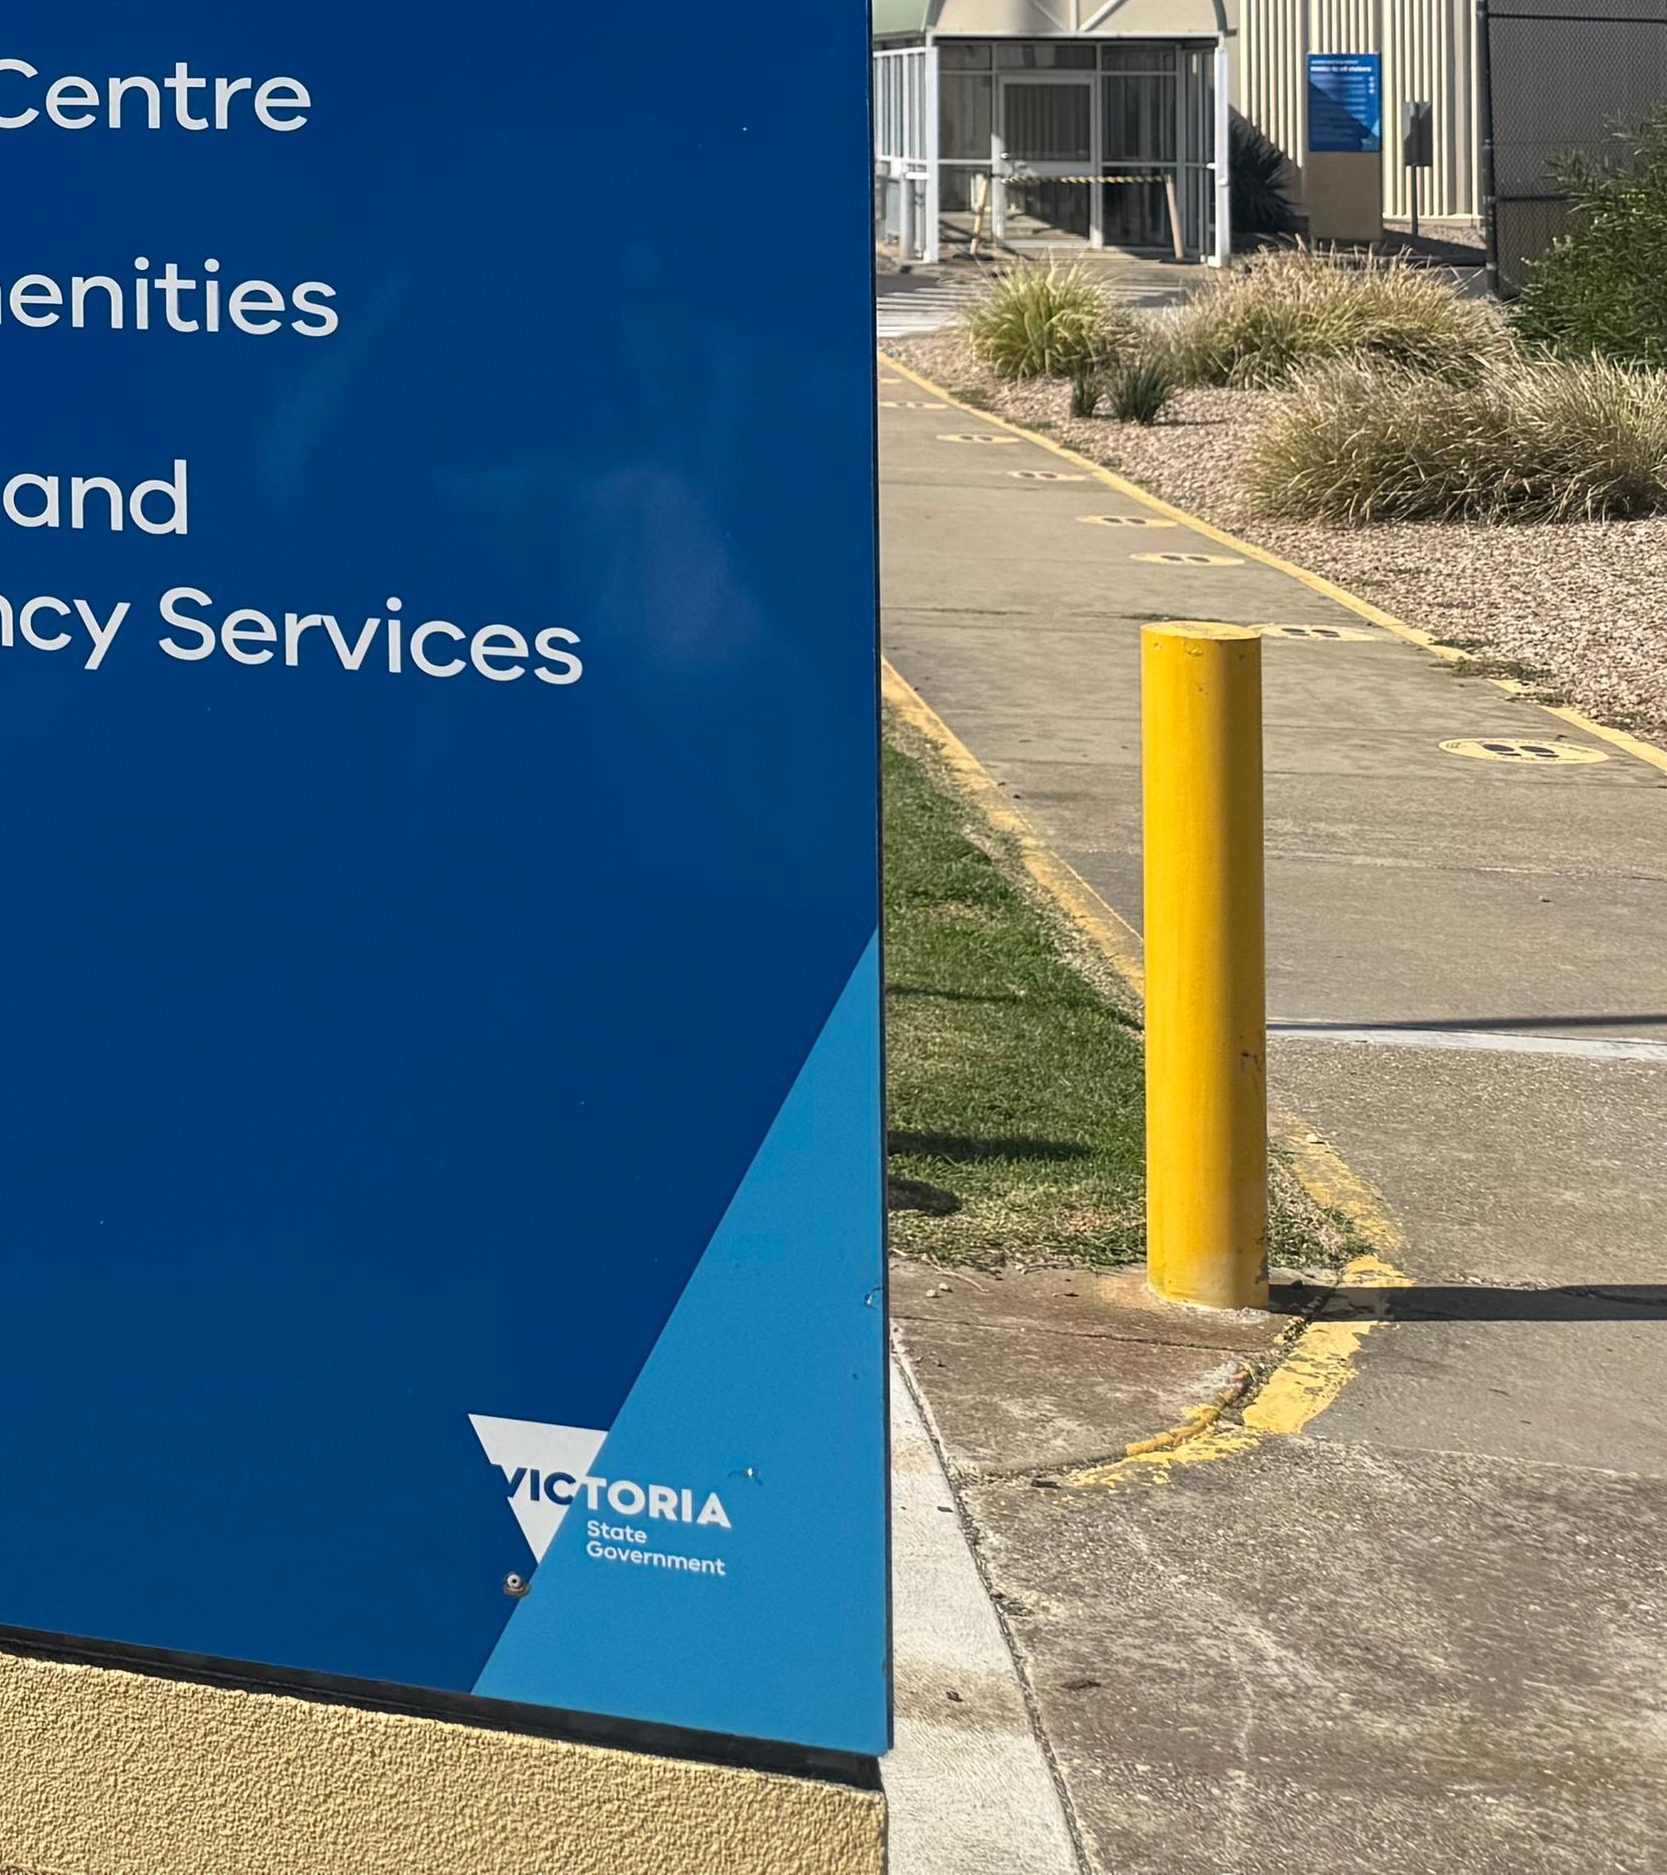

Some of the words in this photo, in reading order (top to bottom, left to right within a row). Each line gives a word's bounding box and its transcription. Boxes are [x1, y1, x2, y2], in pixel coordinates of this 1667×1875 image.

[3, 460, 187, 534] and
[159, 587, 582, 684] Services
[495, 1465, 732, 1529] VICTORIA
[586, 1520, 647, 1543] State
[586, 1541, 726, 1576] Government
